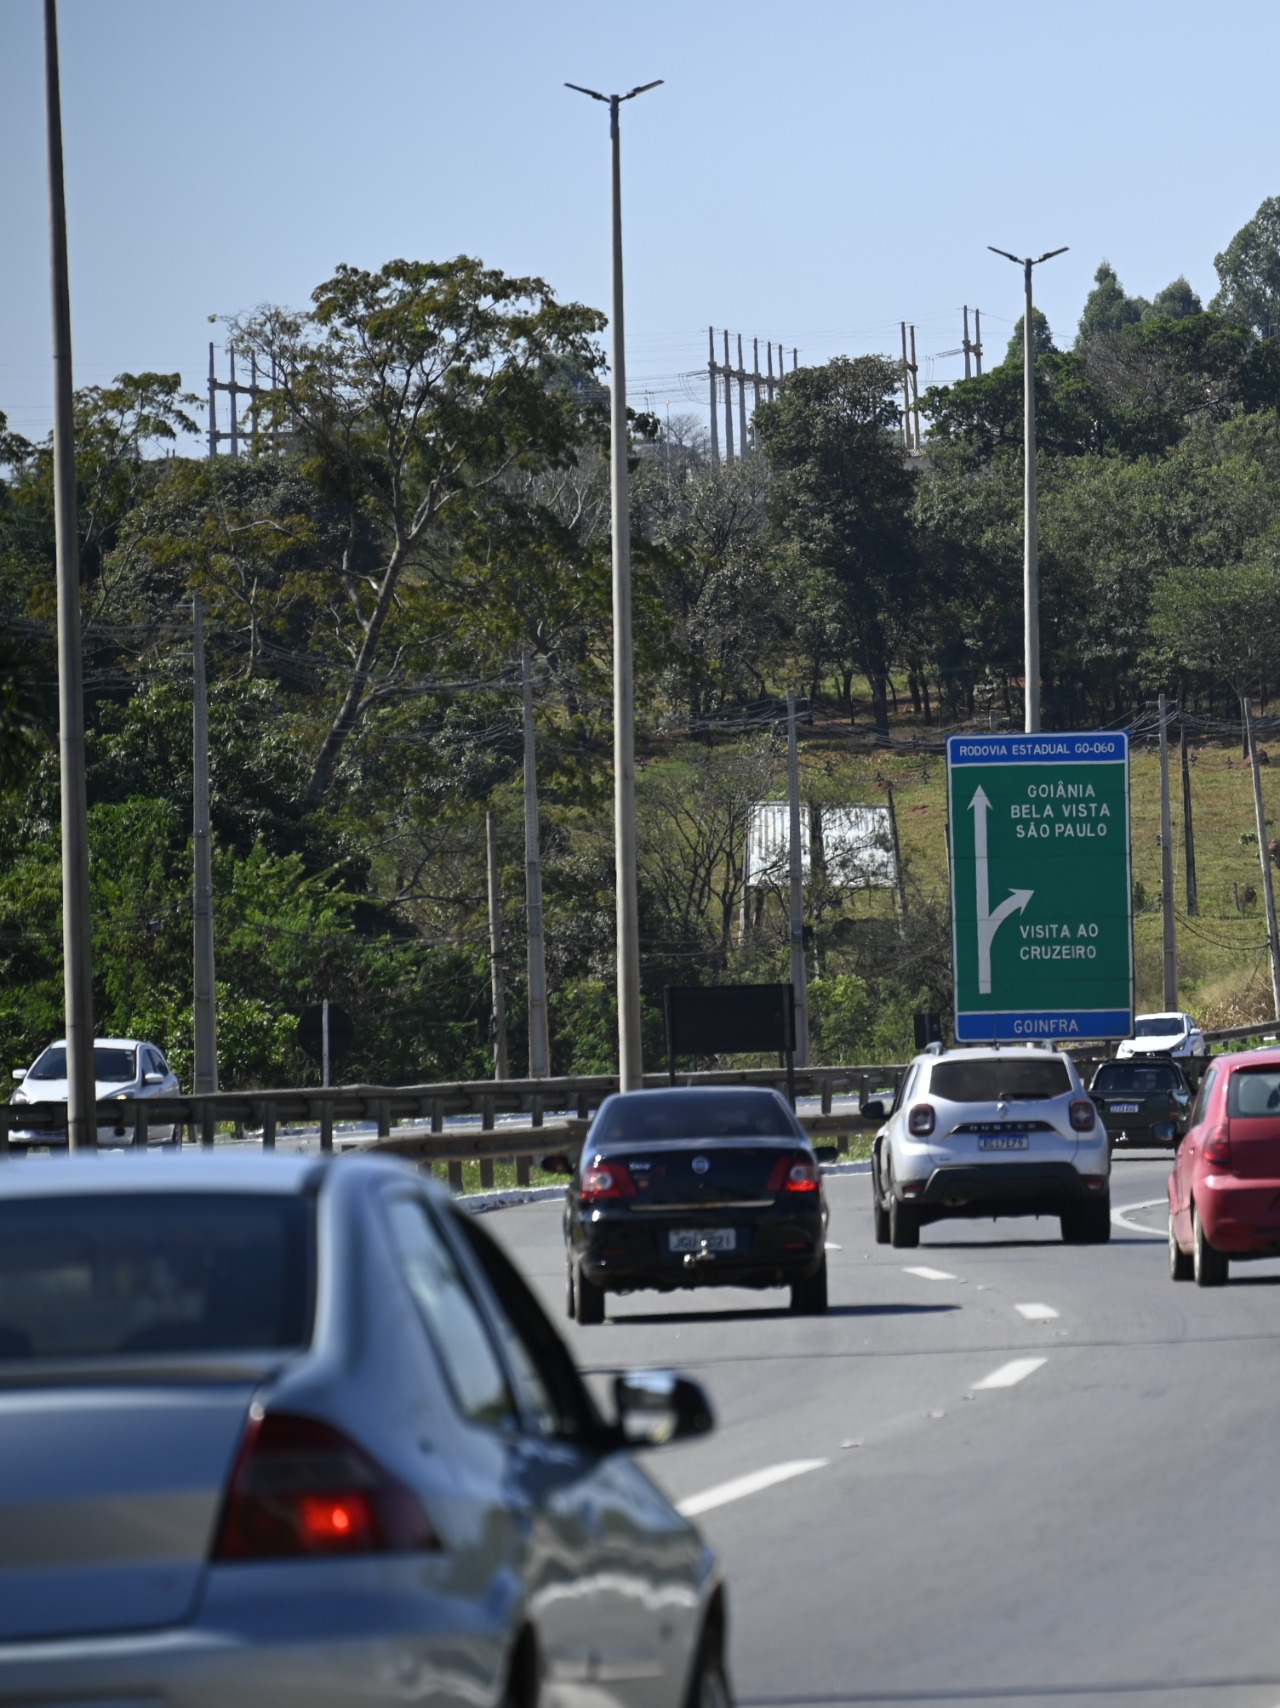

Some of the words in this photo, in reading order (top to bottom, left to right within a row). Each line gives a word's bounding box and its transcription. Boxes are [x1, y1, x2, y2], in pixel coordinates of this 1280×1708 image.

[959, 745, 1008, 757] RODOVIA
[1012, 743, 1070, 755] ESTADUAL
[1074, 742, 1115, 754] GO-060
[1027, 780, 1096, 798] GOIÂNIA
[1010, 804, 1054, 819] BELA
[1061, 803, 1110, 818] VISTA
[1016, 820, 1050, 838] SÃO
[1055, 823, 1107, 837] PAULO
[1019, 924, 1071, 939] VISITA
[1077, 923, 1099, 938] AO
[1019, 946, 1097, 960] CRUZEIRO
[1013, 1019, 1079, 1034] GOINFRA
